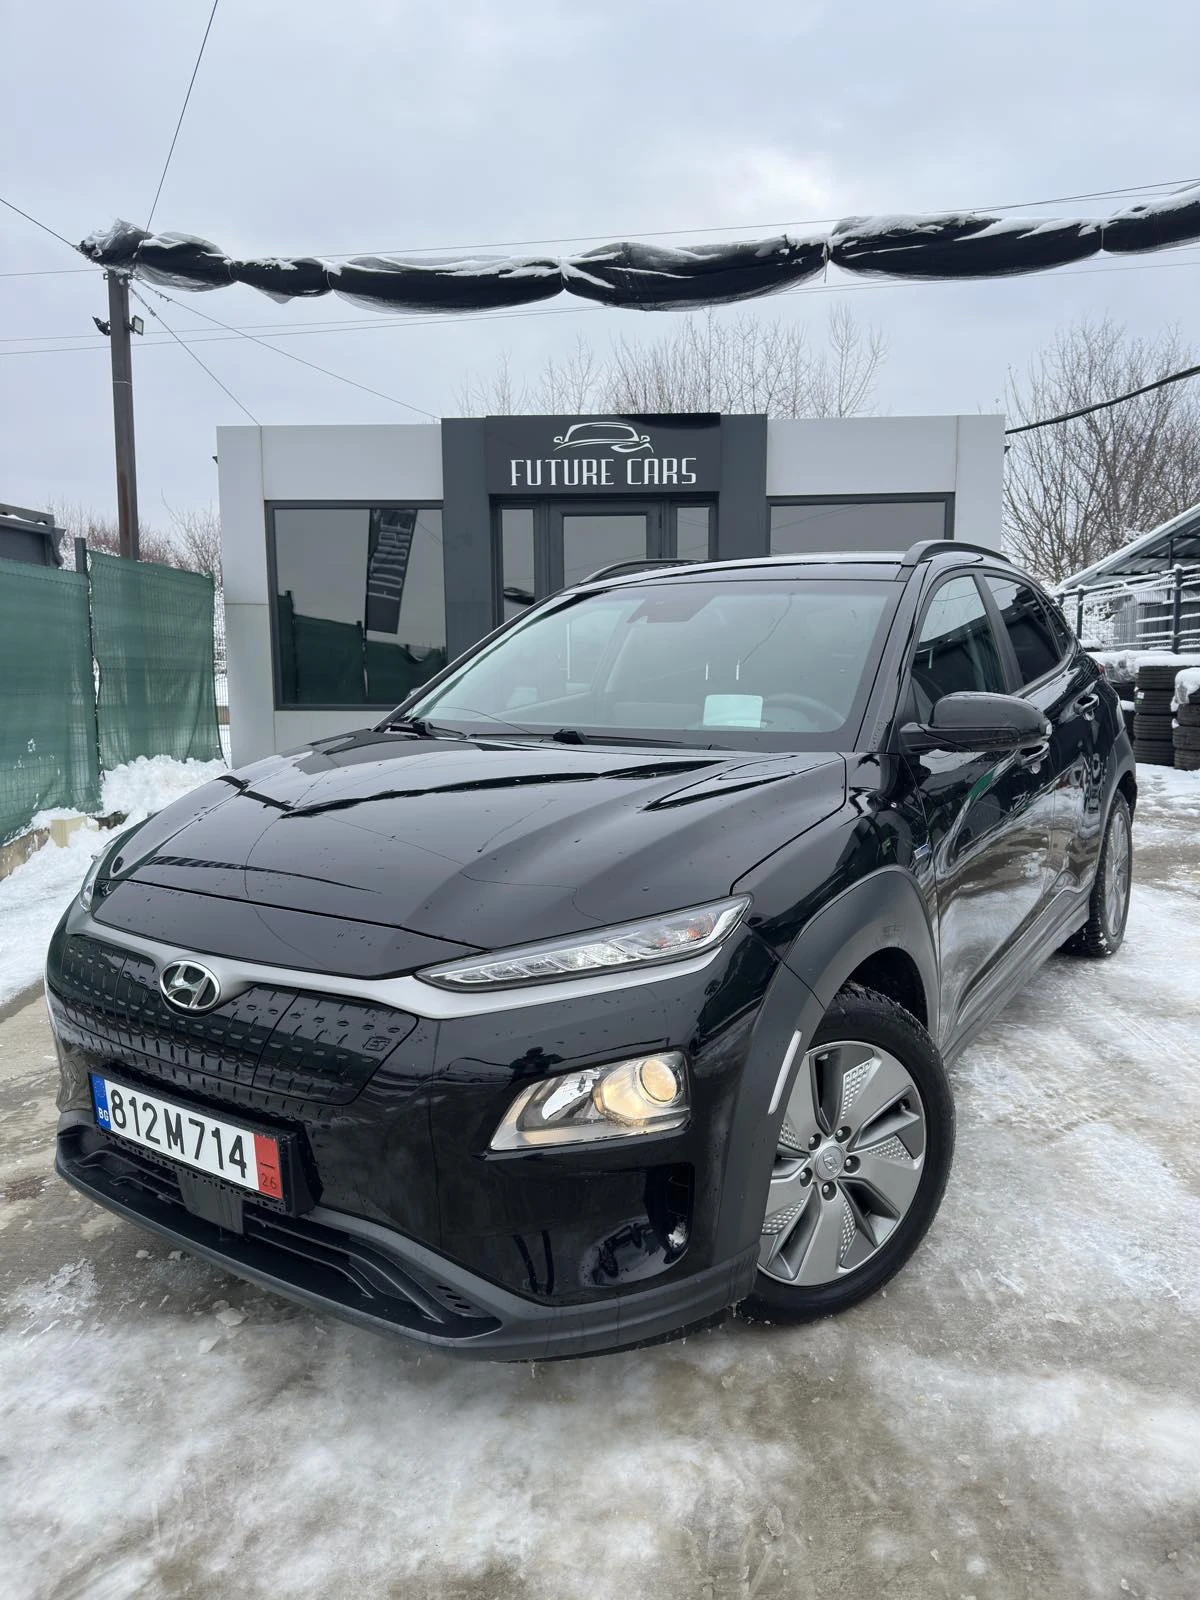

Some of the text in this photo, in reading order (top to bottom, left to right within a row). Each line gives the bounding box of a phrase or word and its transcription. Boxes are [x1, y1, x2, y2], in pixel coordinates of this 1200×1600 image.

[510, 457, 697, 486] FUTURE CARS
[97, 1106, 109, 1121] BG
[110, 1089, 247, 1179] 812M714
[262, 1173, 277, 1190] 26
